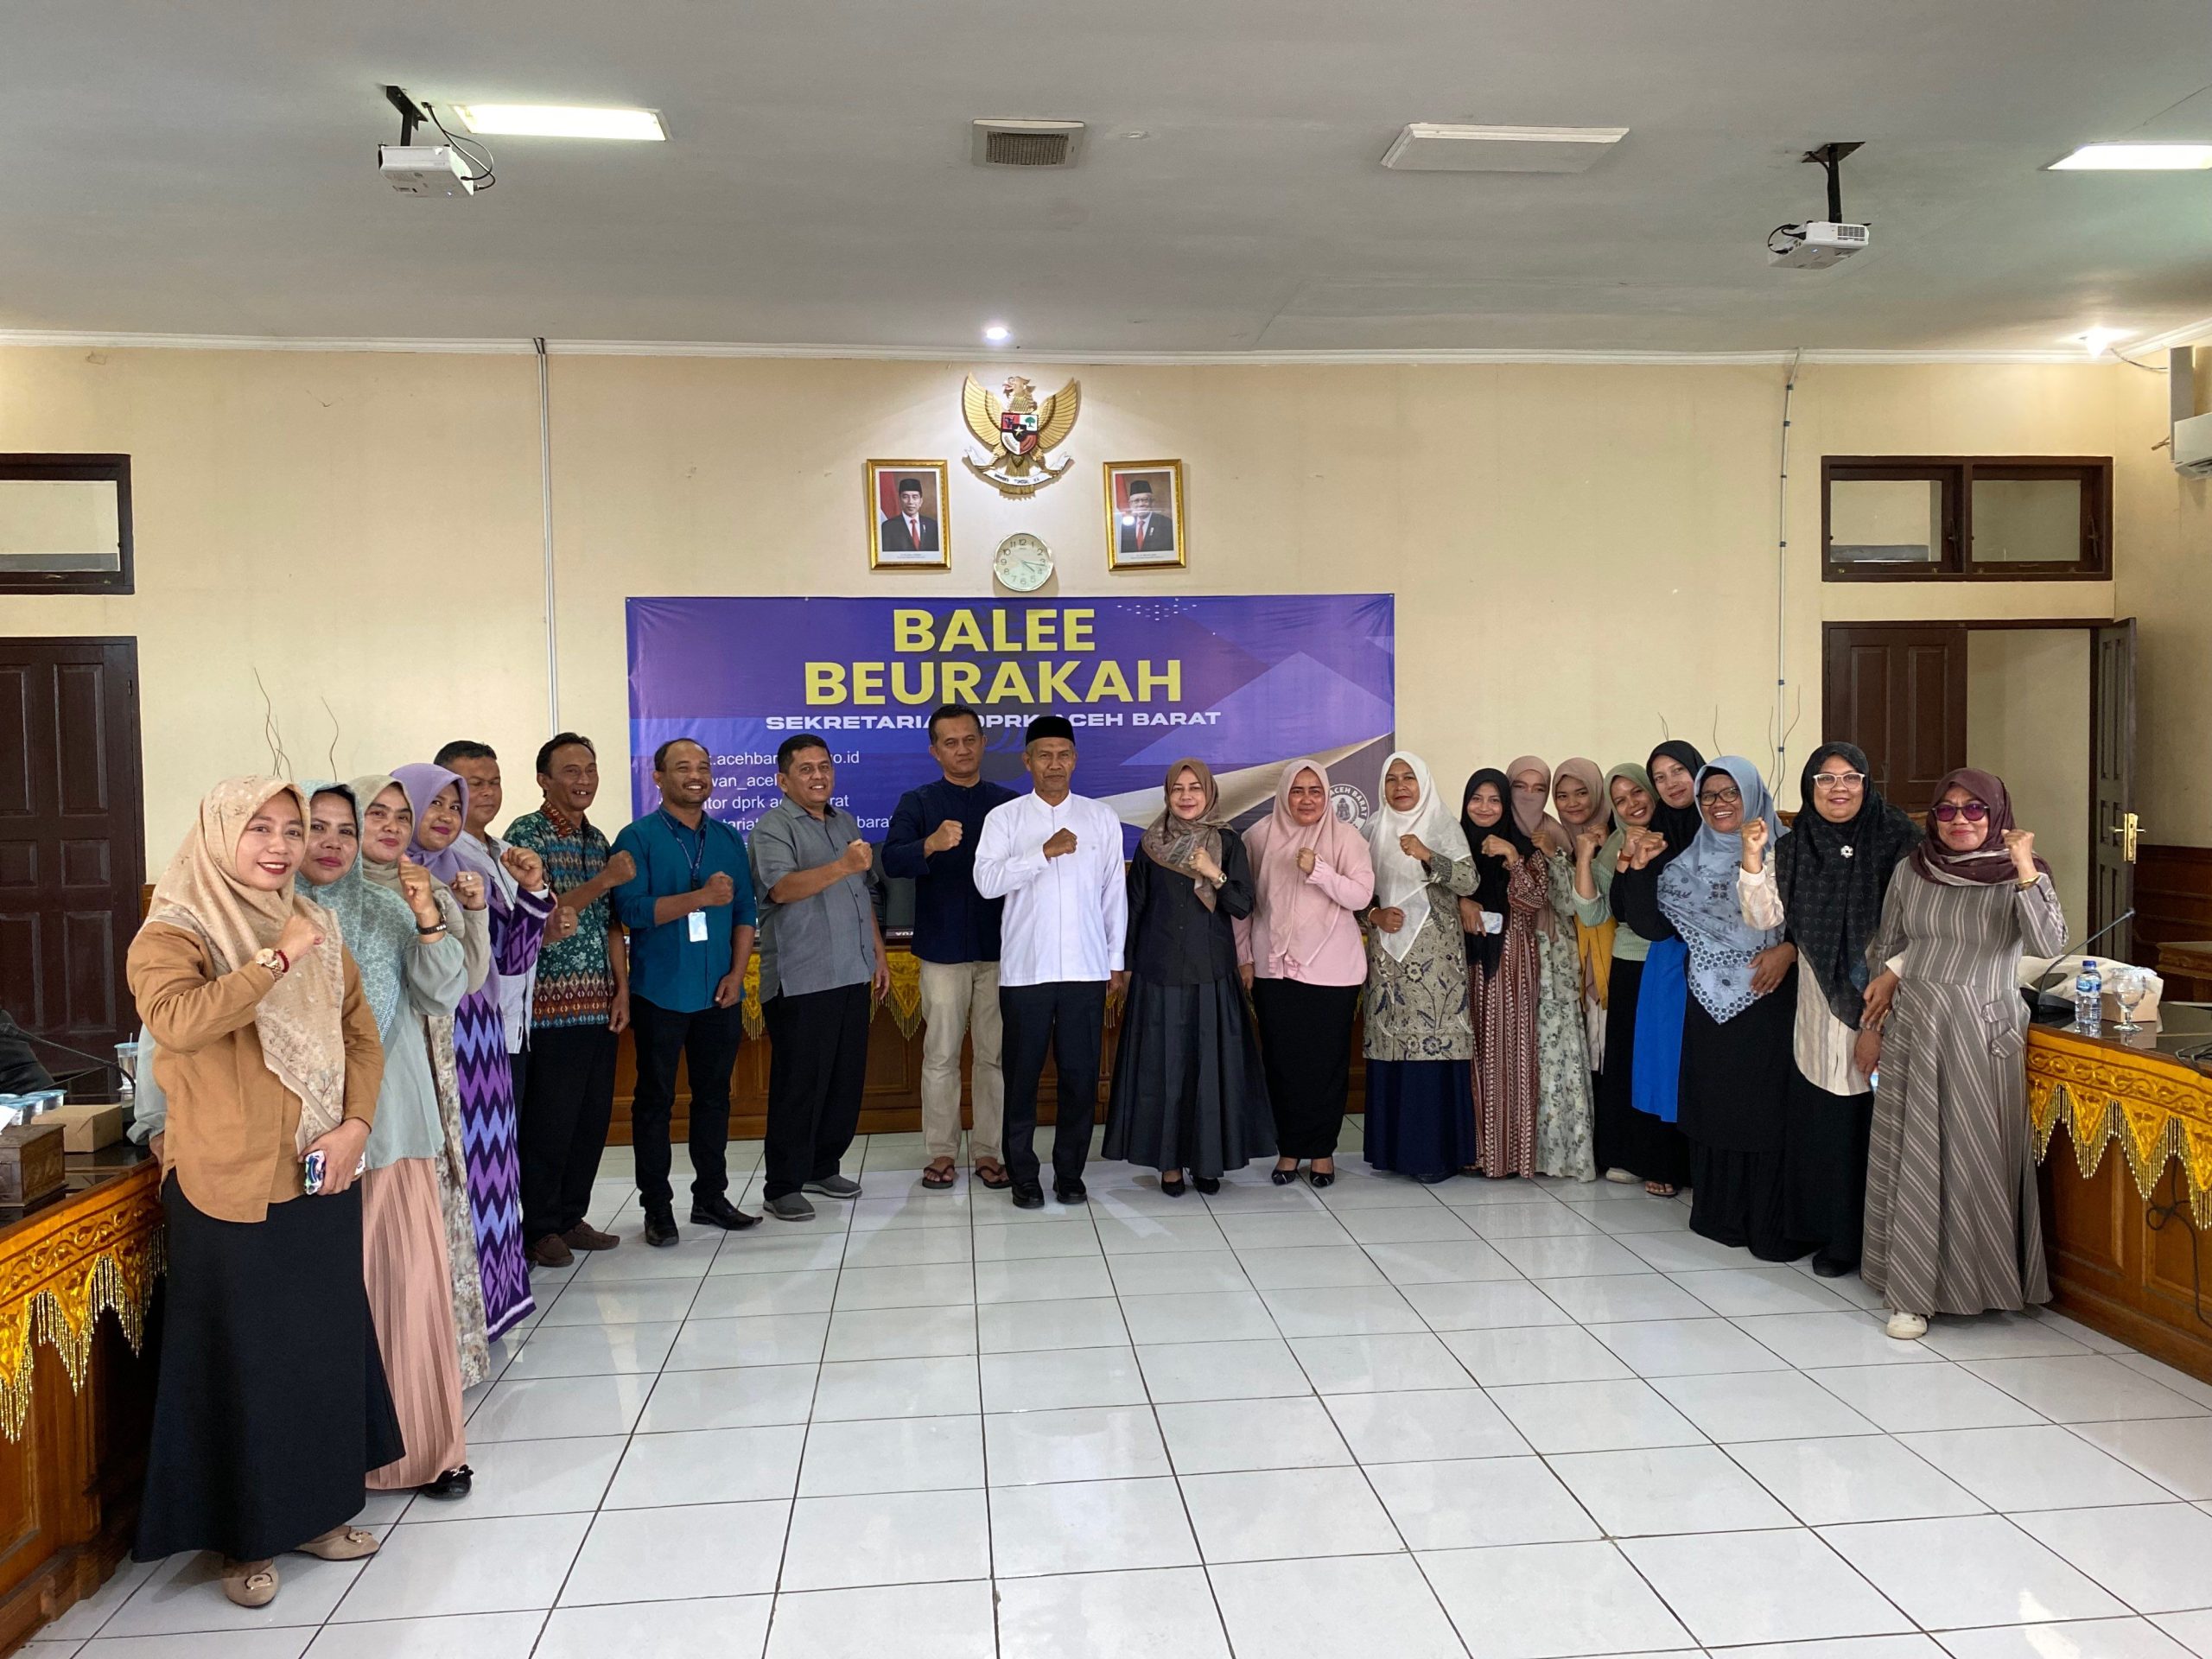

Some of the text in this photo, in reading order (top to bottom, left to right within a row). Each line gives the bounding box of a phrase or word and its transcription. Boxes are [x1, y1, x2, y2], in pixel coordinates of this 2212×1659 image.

[893, 608, 1096, 652] BALEE
[804, 659, 1181, 705] BEURAKAH
[766, 715, 931, 730] SEKRETARI
[1056, 713, 1123, 728] CEH
[1132, 712, 1221, 726] BARAT
[732, 796, 766, 812] dprk
[1352, 790, 1367, 817] BARAT
